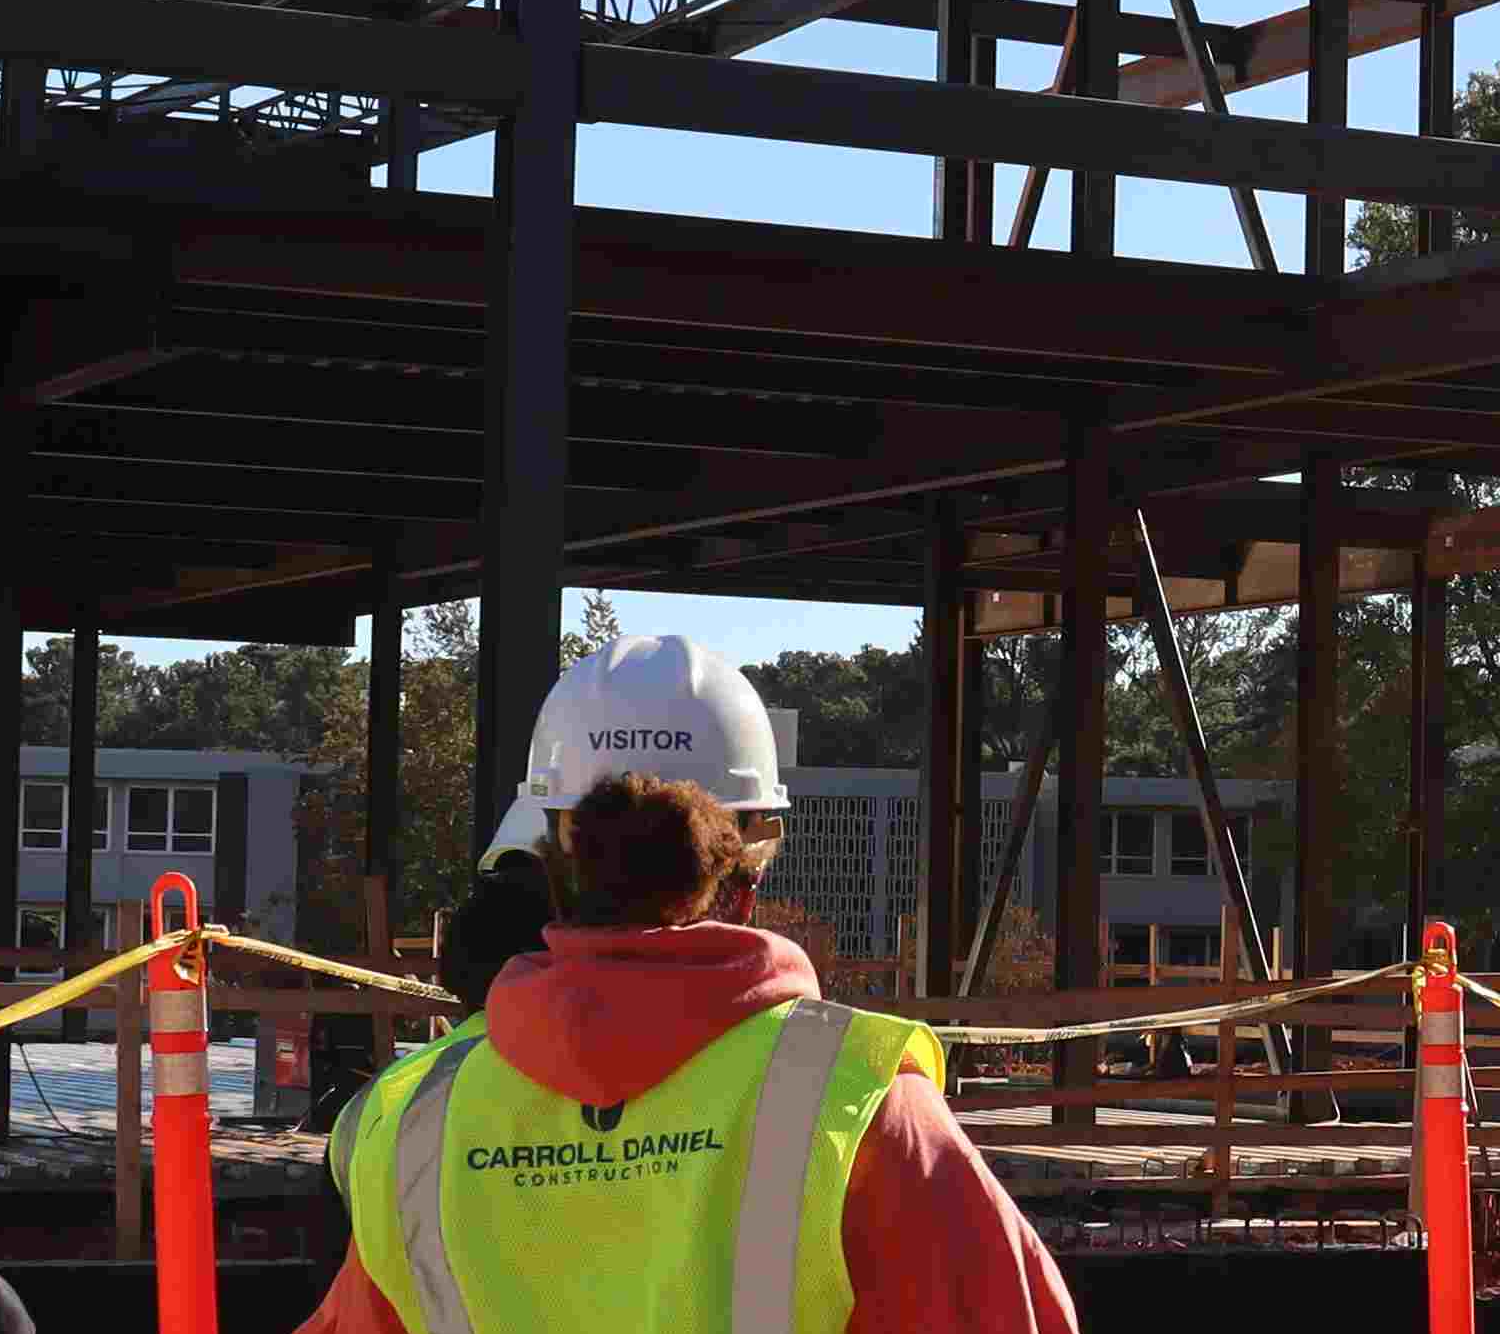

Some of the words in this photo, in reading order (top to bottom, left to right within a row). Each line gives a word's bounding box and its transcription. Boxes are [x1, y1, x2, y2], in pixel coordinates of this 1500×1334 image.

[588, 728, 693, 752] VISITOR
[467, 1142, 613, 1170] CARROLL
[622, 1127, 724, 1162] DANIEL
[514, 1159, 678, 1187] CONSTRUCTION
